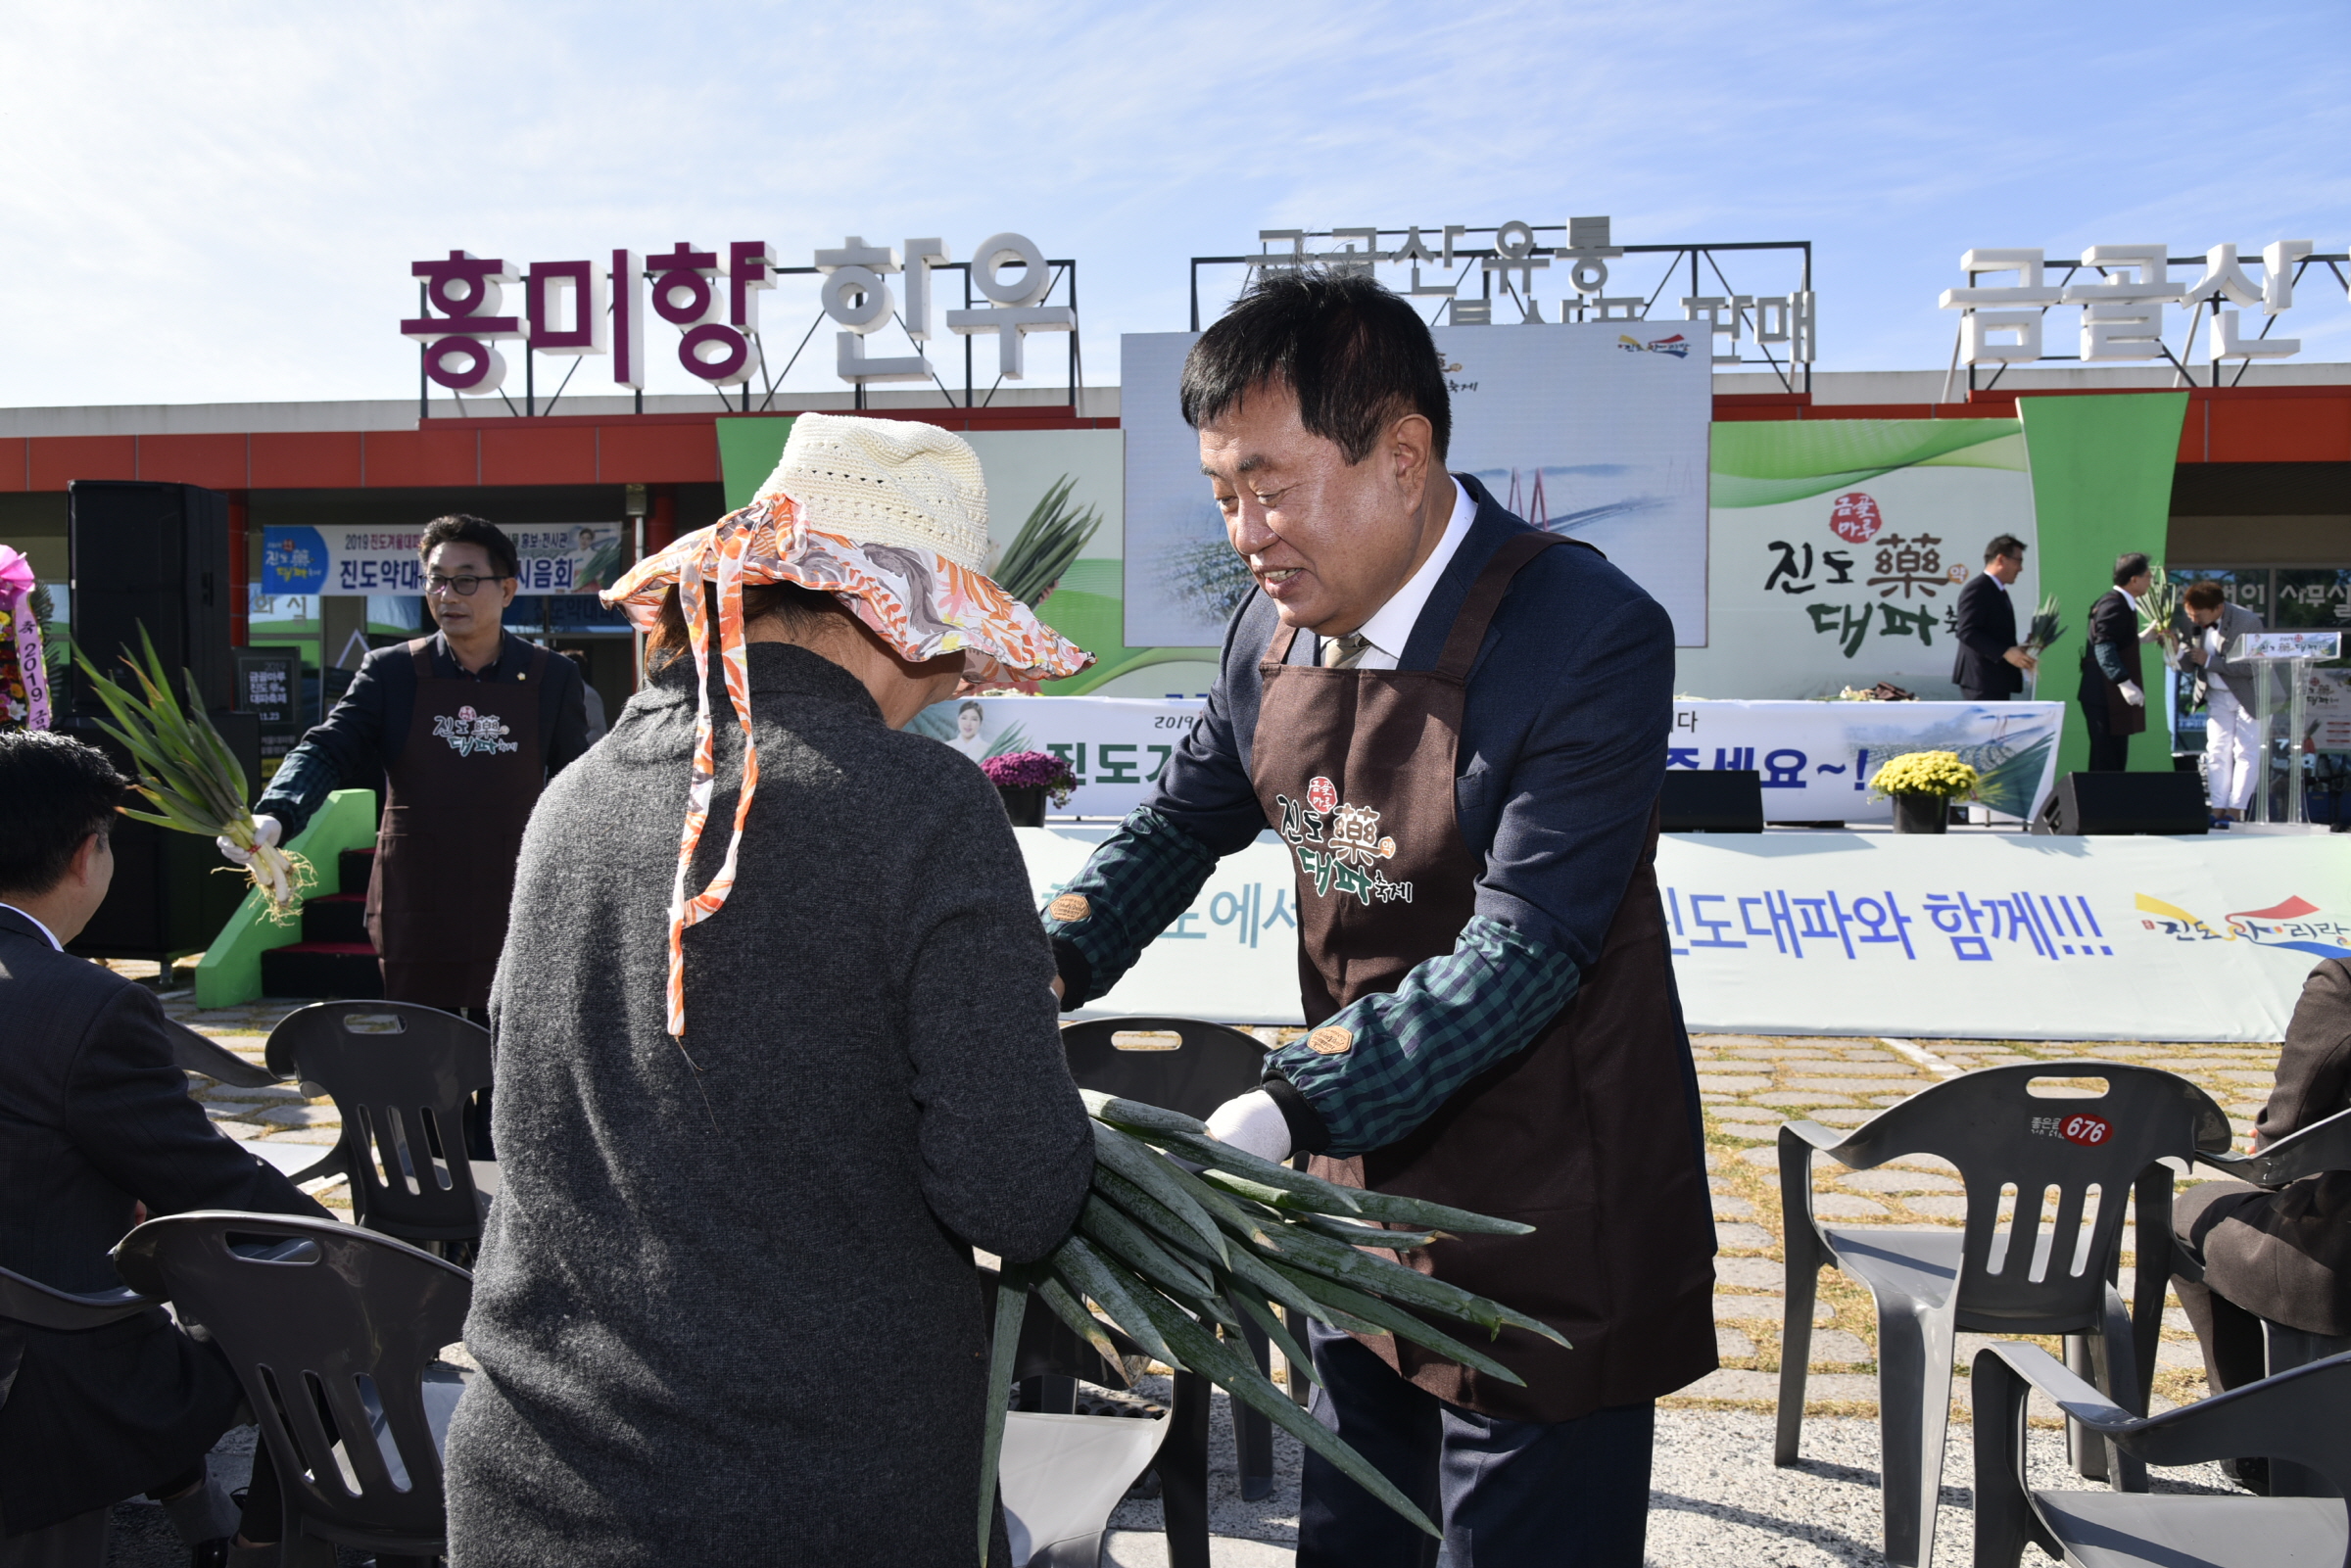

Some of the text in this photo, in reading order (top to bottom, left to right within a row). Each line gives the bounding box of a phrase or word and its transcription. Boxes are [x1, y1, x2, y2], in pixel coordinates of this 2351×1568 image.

[401, 232, 1077, 394] 흥미향 한우
[1939, 240, 2313, 364] 금골산
[1679, 291, 1815, 364] 판매
[1835, 496, 1875, 518] 금골
[346, 534, 368, 550] 2019
[1838, 519, 1875, 539] 마루
[1764, 541, 1854, 594] 진도
[2280, 585, 2351, 618] 사무실
[1805, 601, 1940, 659] 대파
[24, 642, 44, 702] 2019
[432, 715, 470, 737] 진도
[1154, 716, 1195, 729] 2019
[447, 736, 498, 757] 대파
[1311, 781, 1332, 796] 금골
[1313, 796, 1332, 809] 마루
[1276, 794, 1323, 843] 진도
[1296, 846, 1413, 905] 대파 축제
[1922, 890, 2114, 961] 함께!!!
[2067, 1117, 2105, 1143] 676
